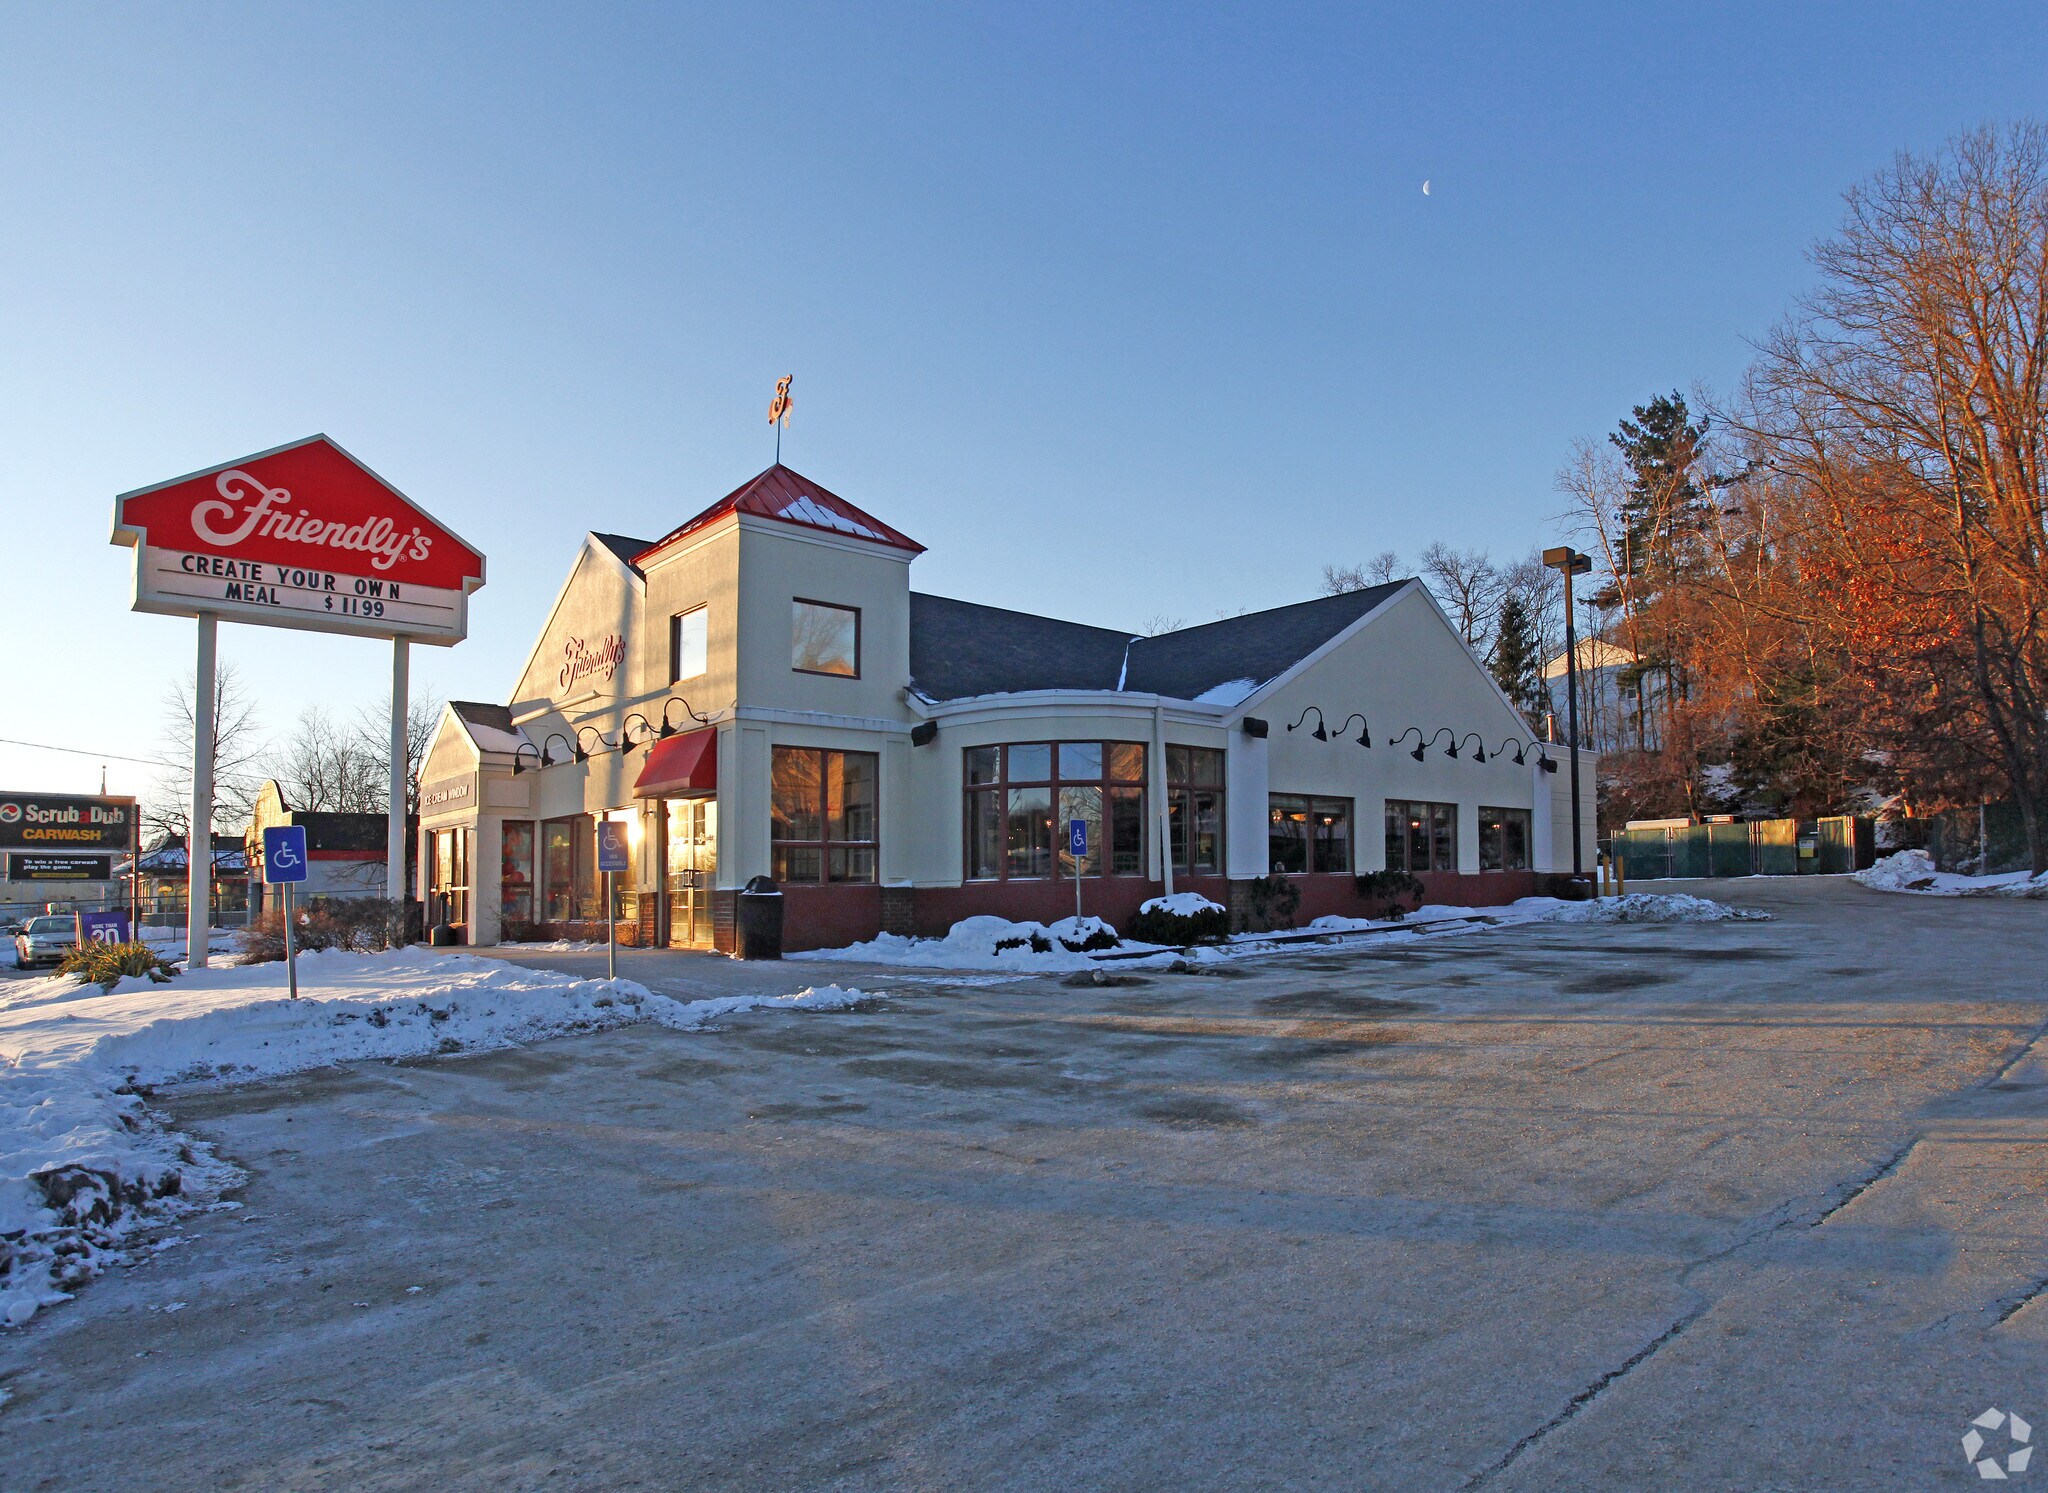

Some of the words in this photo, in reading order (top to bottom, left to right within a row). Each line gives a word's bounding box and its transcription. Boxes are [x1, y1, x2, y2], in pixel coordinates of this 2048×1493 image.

[191, 469, 432, 571] Friendly's
[181, 554, 262, 581] CREATE
[277, 567, 336, 591] YOUR
[354, 579, 400, 599] OWN
[225, 582, 280, 605] MEAL
[560, 634, 626, 696] Friendly's
[23, 828, 102, 841] CARWASH
